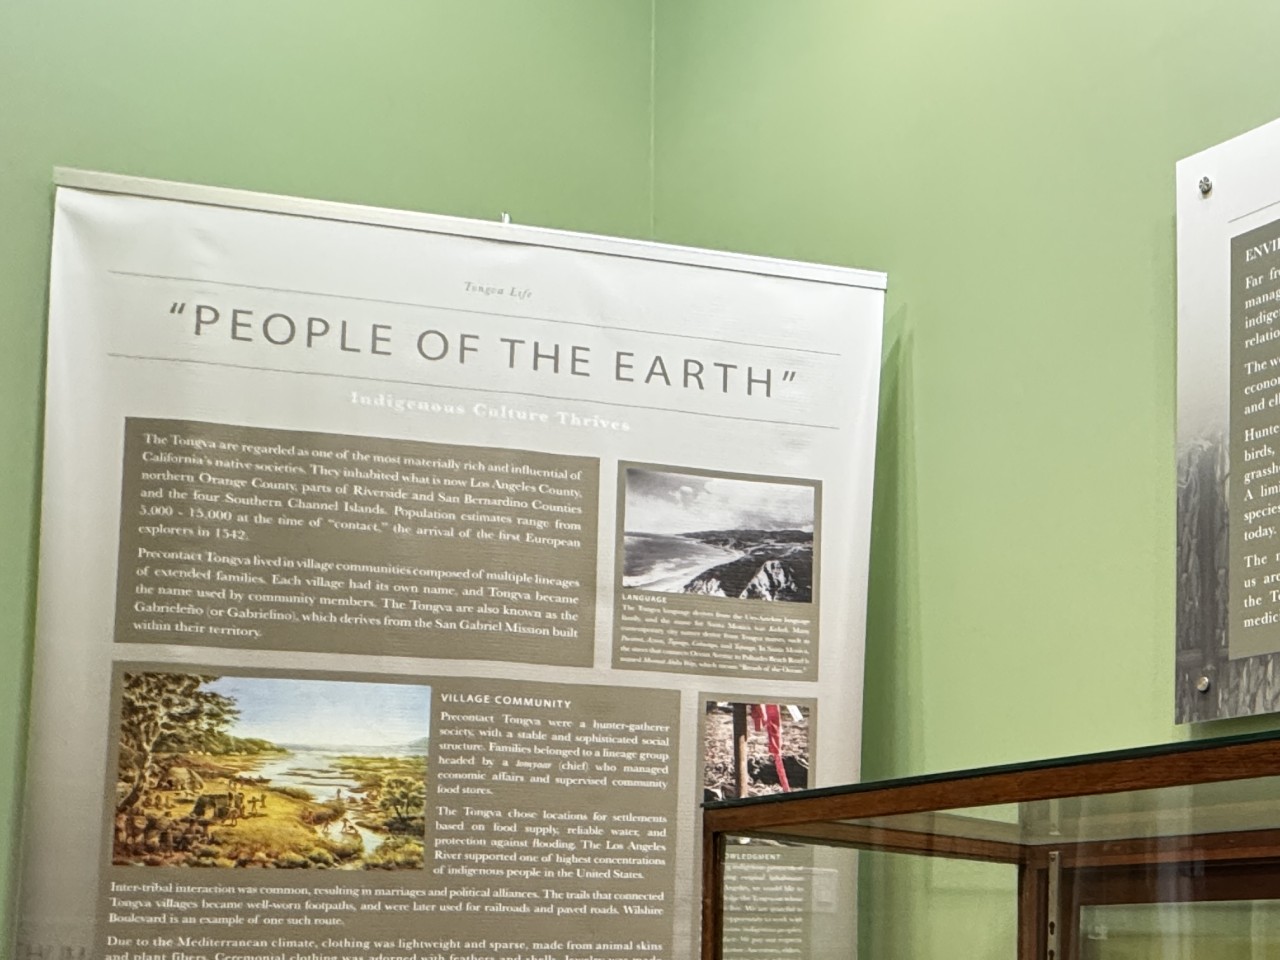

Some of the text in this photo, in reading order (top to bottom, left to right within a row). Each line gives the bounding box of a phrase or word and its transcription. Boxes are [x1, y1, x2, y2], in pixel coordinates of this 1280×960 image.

[1245, 275, 1263, 289] Far
[464, 281, 532, 300] Tongva Life
[416, 329, 479, 364] OF
[499, 337, 590, 377] THE
[351, 391, 630, 431] Indigenous Culture Thrives
[145, 433, 167, 445] The
[173, 434, 216, 449] Tongva
[218, 441, 239, 451] are
[241, 444, 295, 455] regarded
[311, 449, 333, 458] one
[335, 449, 349, 460] of
[351, 450, 371, 461] the
[372, 455, 401, 465] most
[403, 457, 460, 471] materially
[463, 461, 485, 471] rich
[487, 462, 509, 473] and
[510, 464, 568, 479] influential
[569, 470, 582, 480] of
[138, 523, 194, 536] explorers
[197, 526, 210, 537] in
[1243, 553, 1267, 568] The
[1244, 578, 1256, 588] us
[622, 593, 667, 603] LANGUAGE
[1243, 594, 1262, 608] the
[440, 693, 571, 708] VILLAGE COMMUNITY
[435, 806, 667, 823] The Tongva chose locations for settlements
